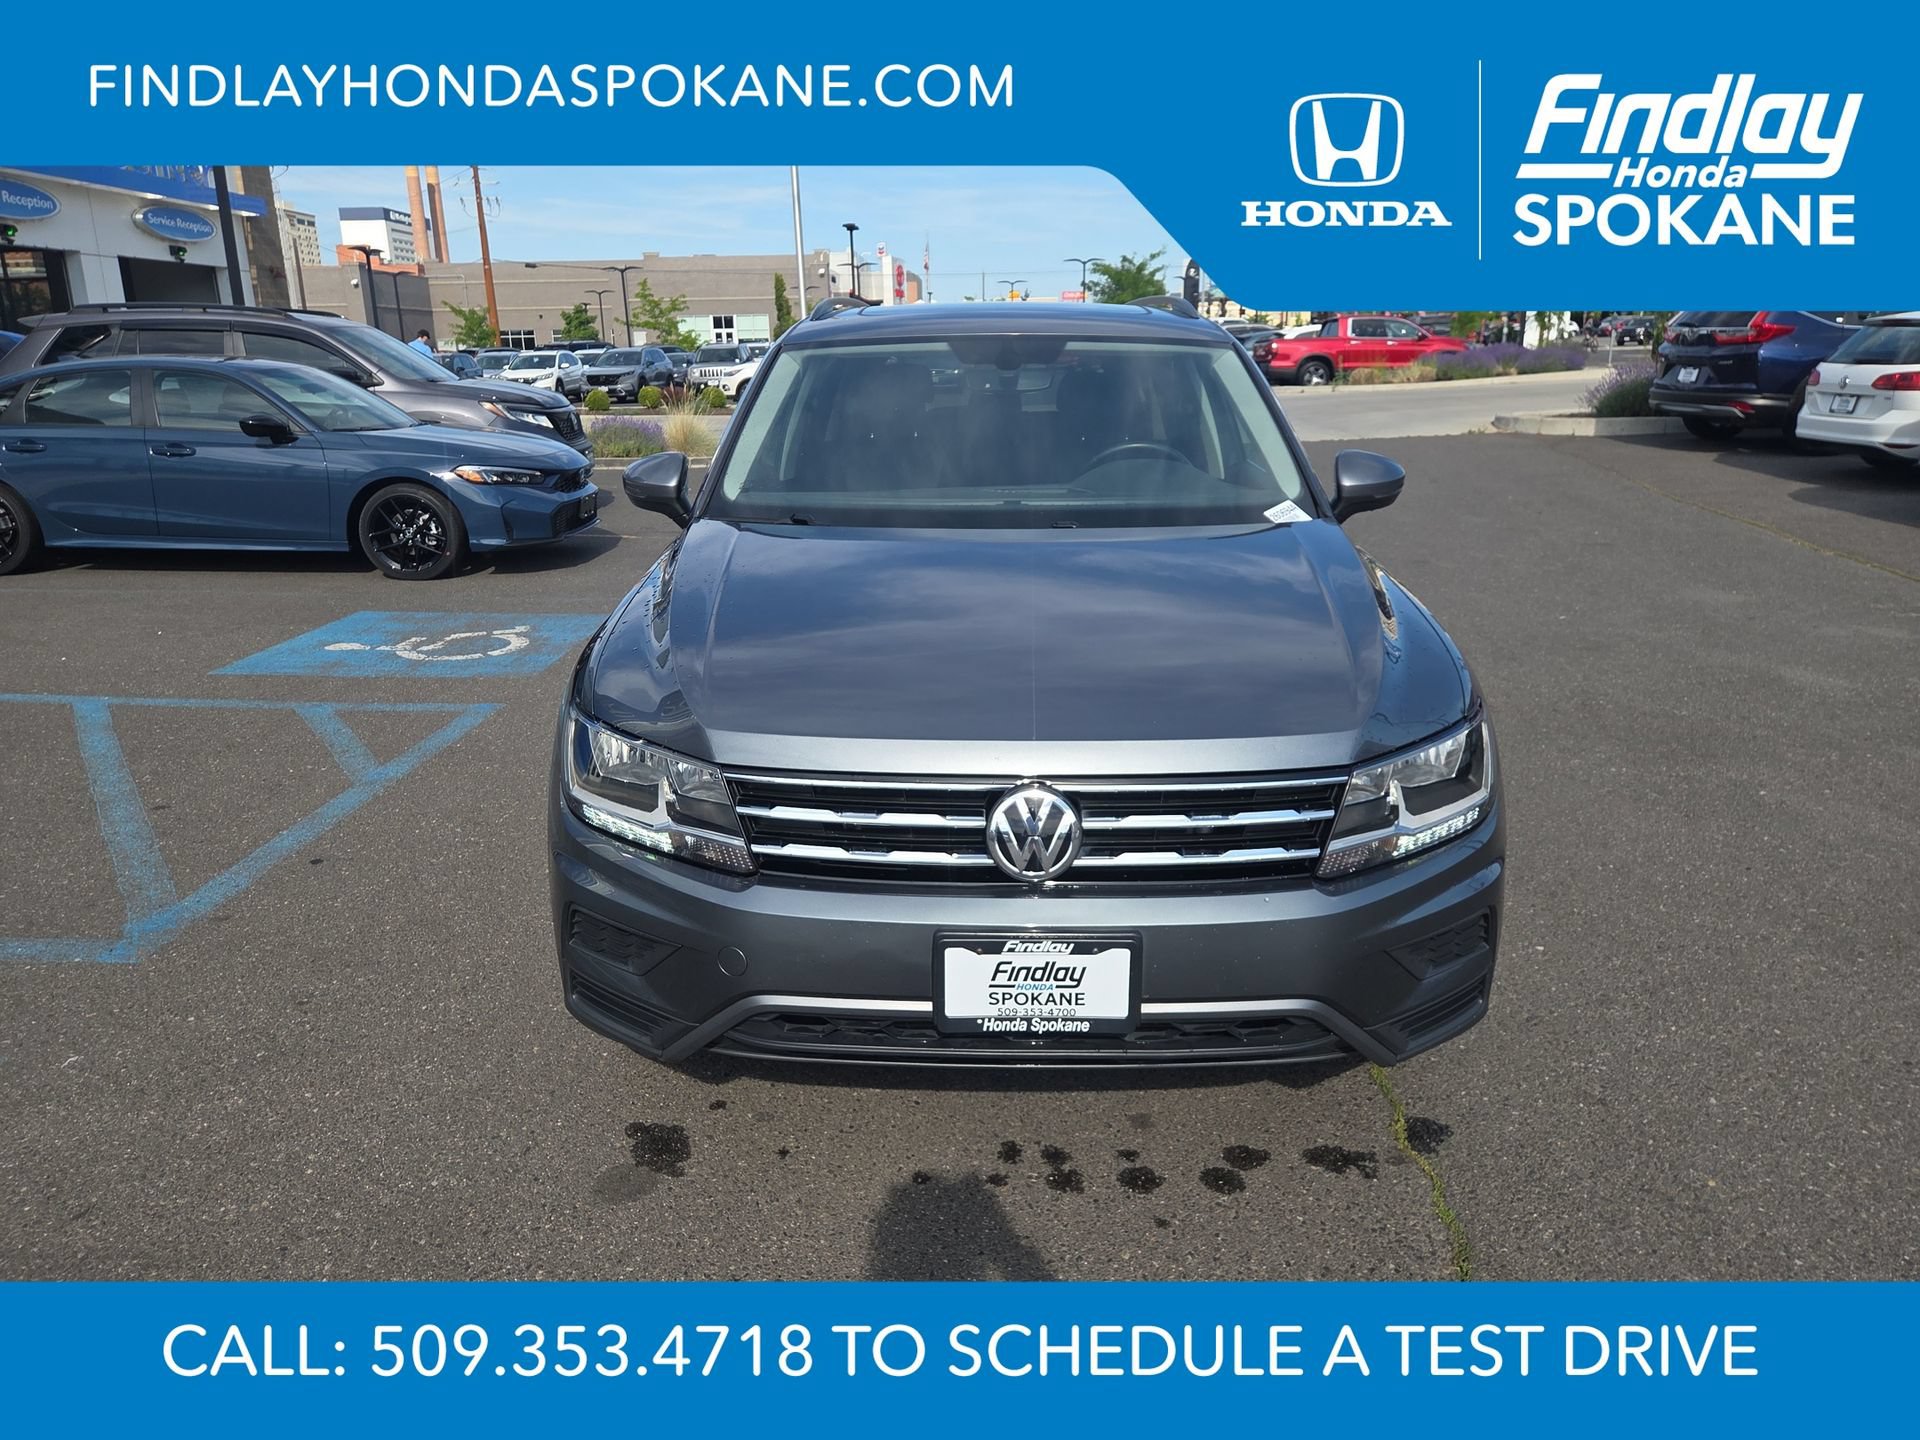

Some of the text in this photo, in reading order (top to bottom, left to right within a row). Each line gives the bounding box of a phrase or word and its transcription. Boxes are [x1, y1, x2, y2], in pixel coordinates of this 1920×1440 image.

[1, 190, 54, 211] Reception
[147, 212, 213, 233] Service Reception
[1001, 940, 1075, 955] Findlay
[990, 961, 1087, 988] Findlay
[1016, 983, 1054, 991] HONDA
[988, 992, 1086, 1006] SPOKANE
[997, 1007, 1077, 1017] 509-353-4700
[982, 1017, 1091, 1035] Honda Spokane
